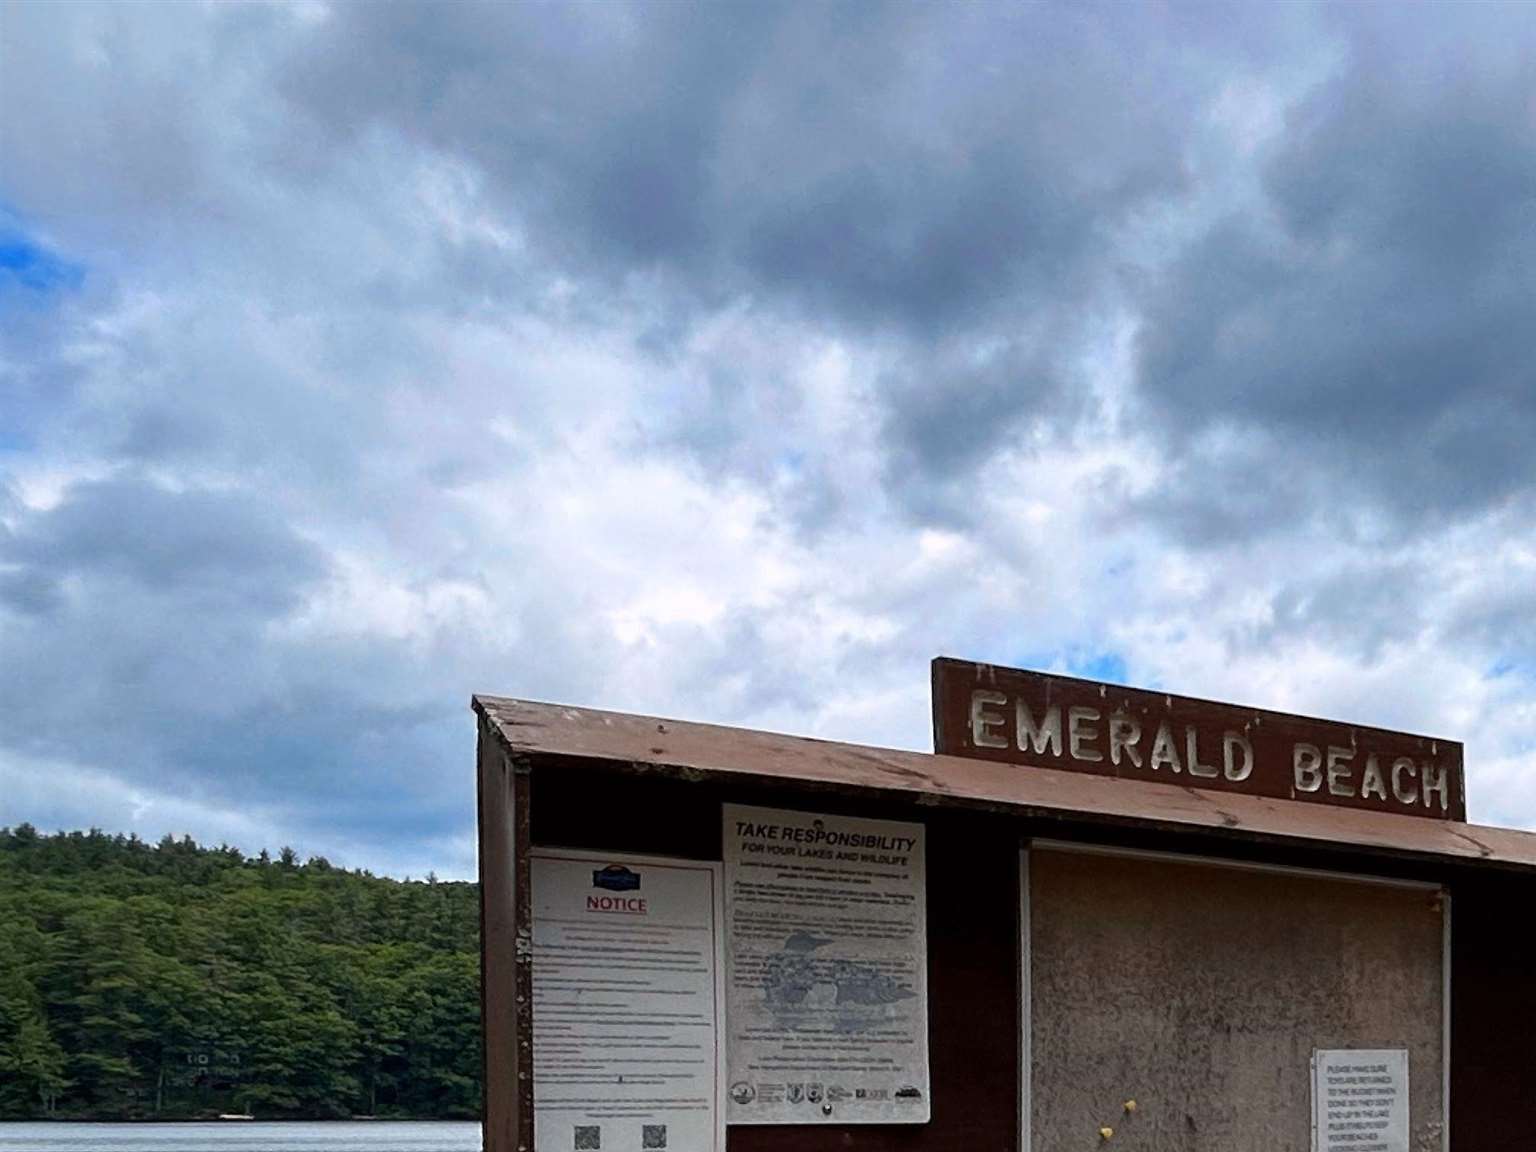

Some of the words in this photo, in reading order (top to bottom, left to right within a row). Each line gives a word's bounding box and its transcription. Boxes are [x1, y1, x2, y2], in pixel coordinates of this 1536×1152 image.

[971, 690, 1255, 782] EMERALD
[1293, 742, 1449, 812] BEACH
[736, 821, 779, 839] TAKE
[782, 827, 916, 851] RESPONSIBILITY
[742, 843, 765, 852] FOR
[767, 844, 796, 856] YOUR
[799, 848, 833, 860] LAKES
[835, 851, 858, 862] AND
[860, 853, 908, 867] WILDLIFE
[586, 896, 647, 912] NOTICE
